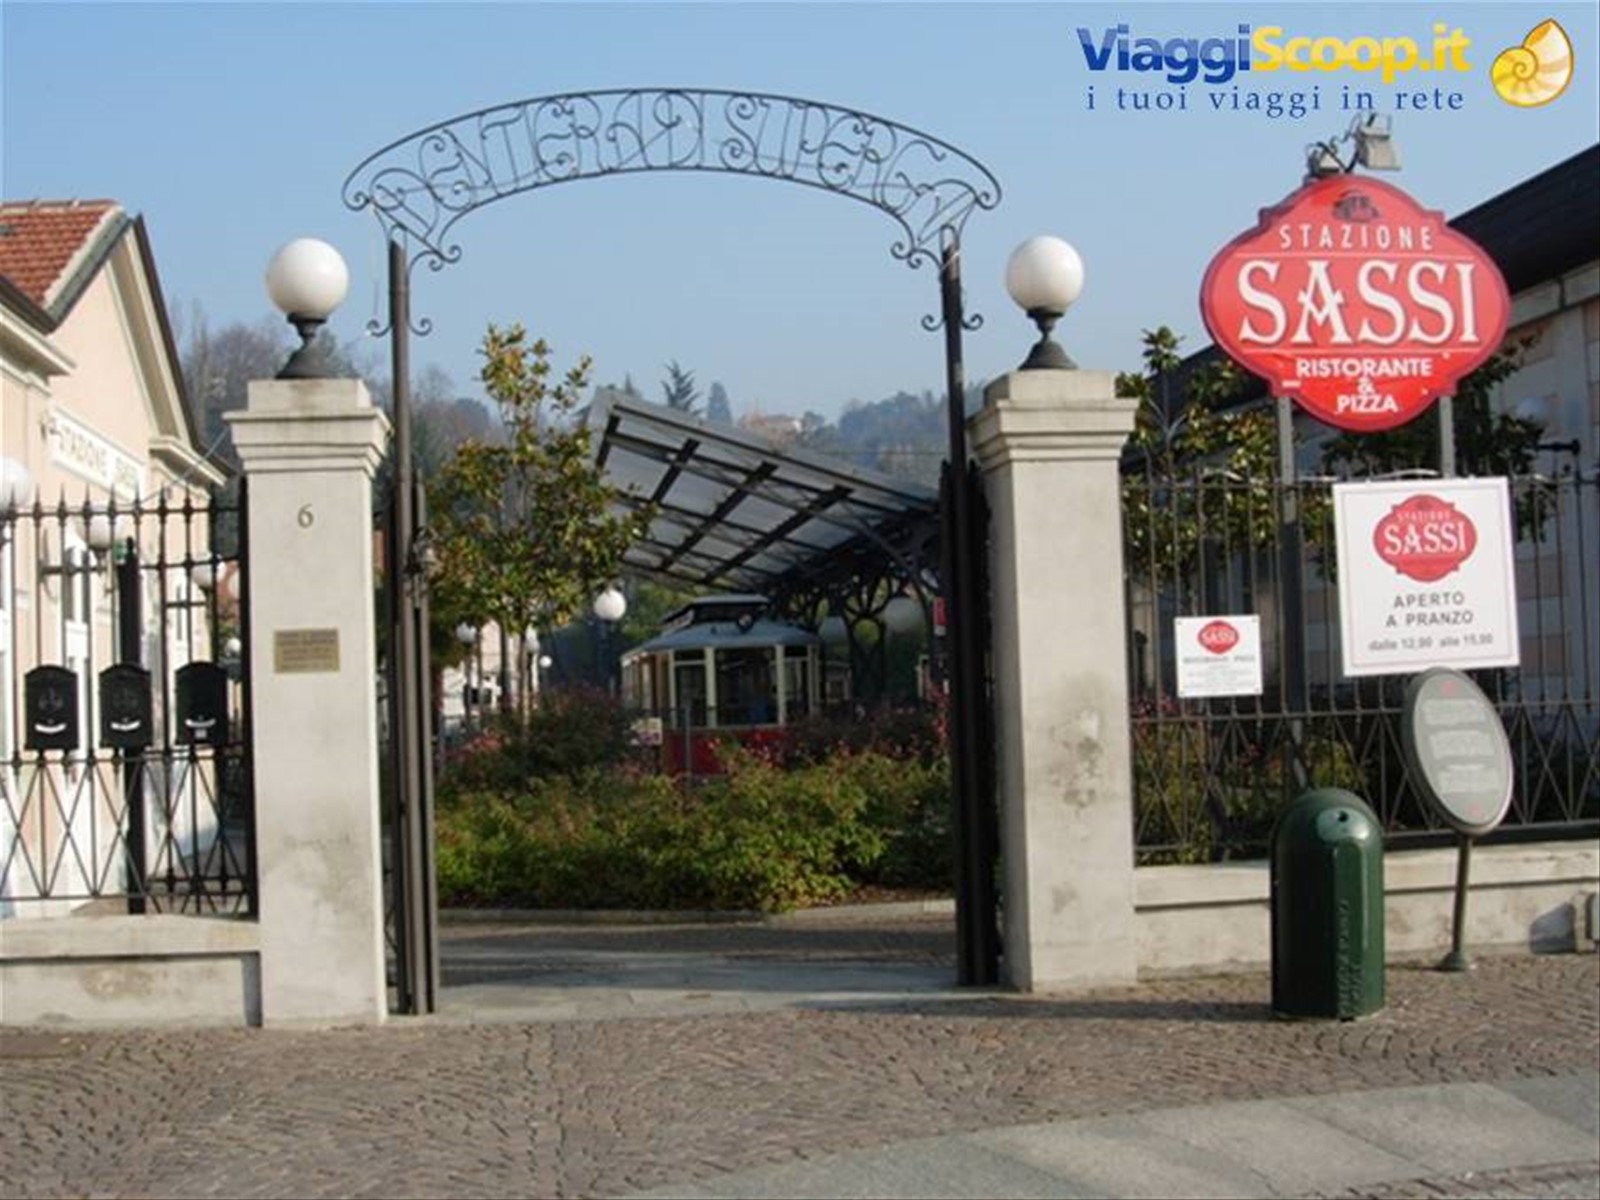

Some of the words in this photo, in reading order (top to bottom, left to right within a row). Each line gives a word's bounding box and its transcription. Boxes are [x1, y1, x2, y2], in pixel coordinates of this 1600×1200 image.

[1279, 225, 1433, 250] STAZIONE
[1238, 259, 1480, 346] SASSI
[1296, 357, 1433, 378] RISTORANTE
[1337, 394, 1399, 414] PIZZA
[297, 502, 314, 529] 6
[1383, 520, 1468, 556] SASSI
[1394, 591, 1465, 608] APERTO
[1386, 614, 1398, 627] A
[1405, 610, 1474, 627] PRANZO
[1369, 638, 1398, 651] dalle
[1439, 635, 1461, 648] alle
